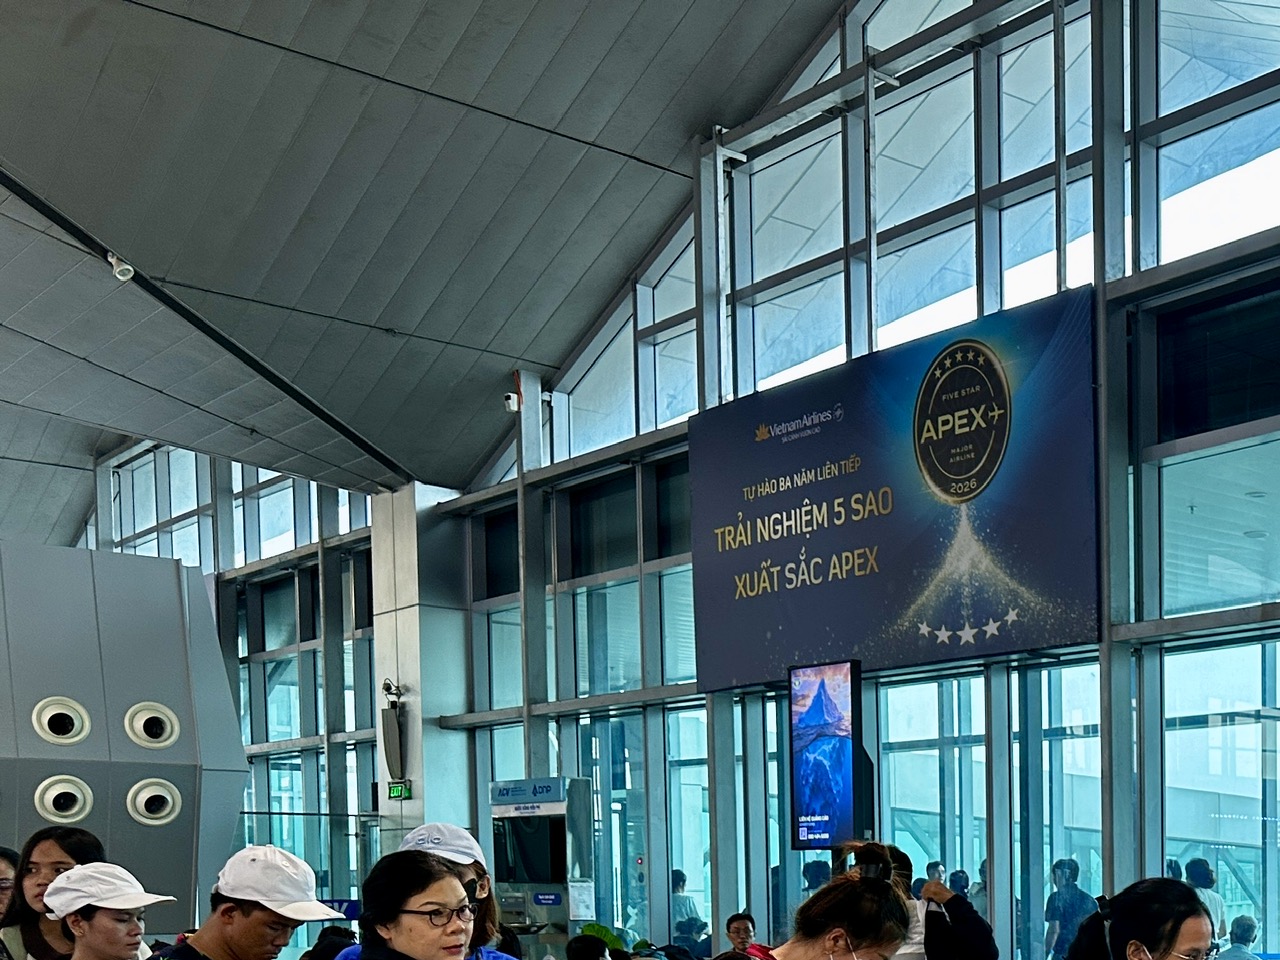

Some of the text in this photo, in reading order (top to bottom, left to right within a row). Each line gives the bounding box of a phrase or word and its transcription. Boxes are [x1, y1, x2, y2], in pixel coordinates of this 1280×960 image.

[943, 386, 980, 401] FIVE STAR
[921, 404, 987, 444] APEX
[951, 444, 973, 454] MAJOR
[950, 452, 975, 463] AIRLINE
[743, 453, 861, 502] TỰ HÀO BA NĂM LIÊN TIẾP
[950, 478, 977, 493] 2026
[714, 486, 892, 552] TRẢI NGHIỆM 5 SAO
[734, 546, 879, 600] XUẤT SẮC APEX
[391, 786, 402, 796] EXIT
